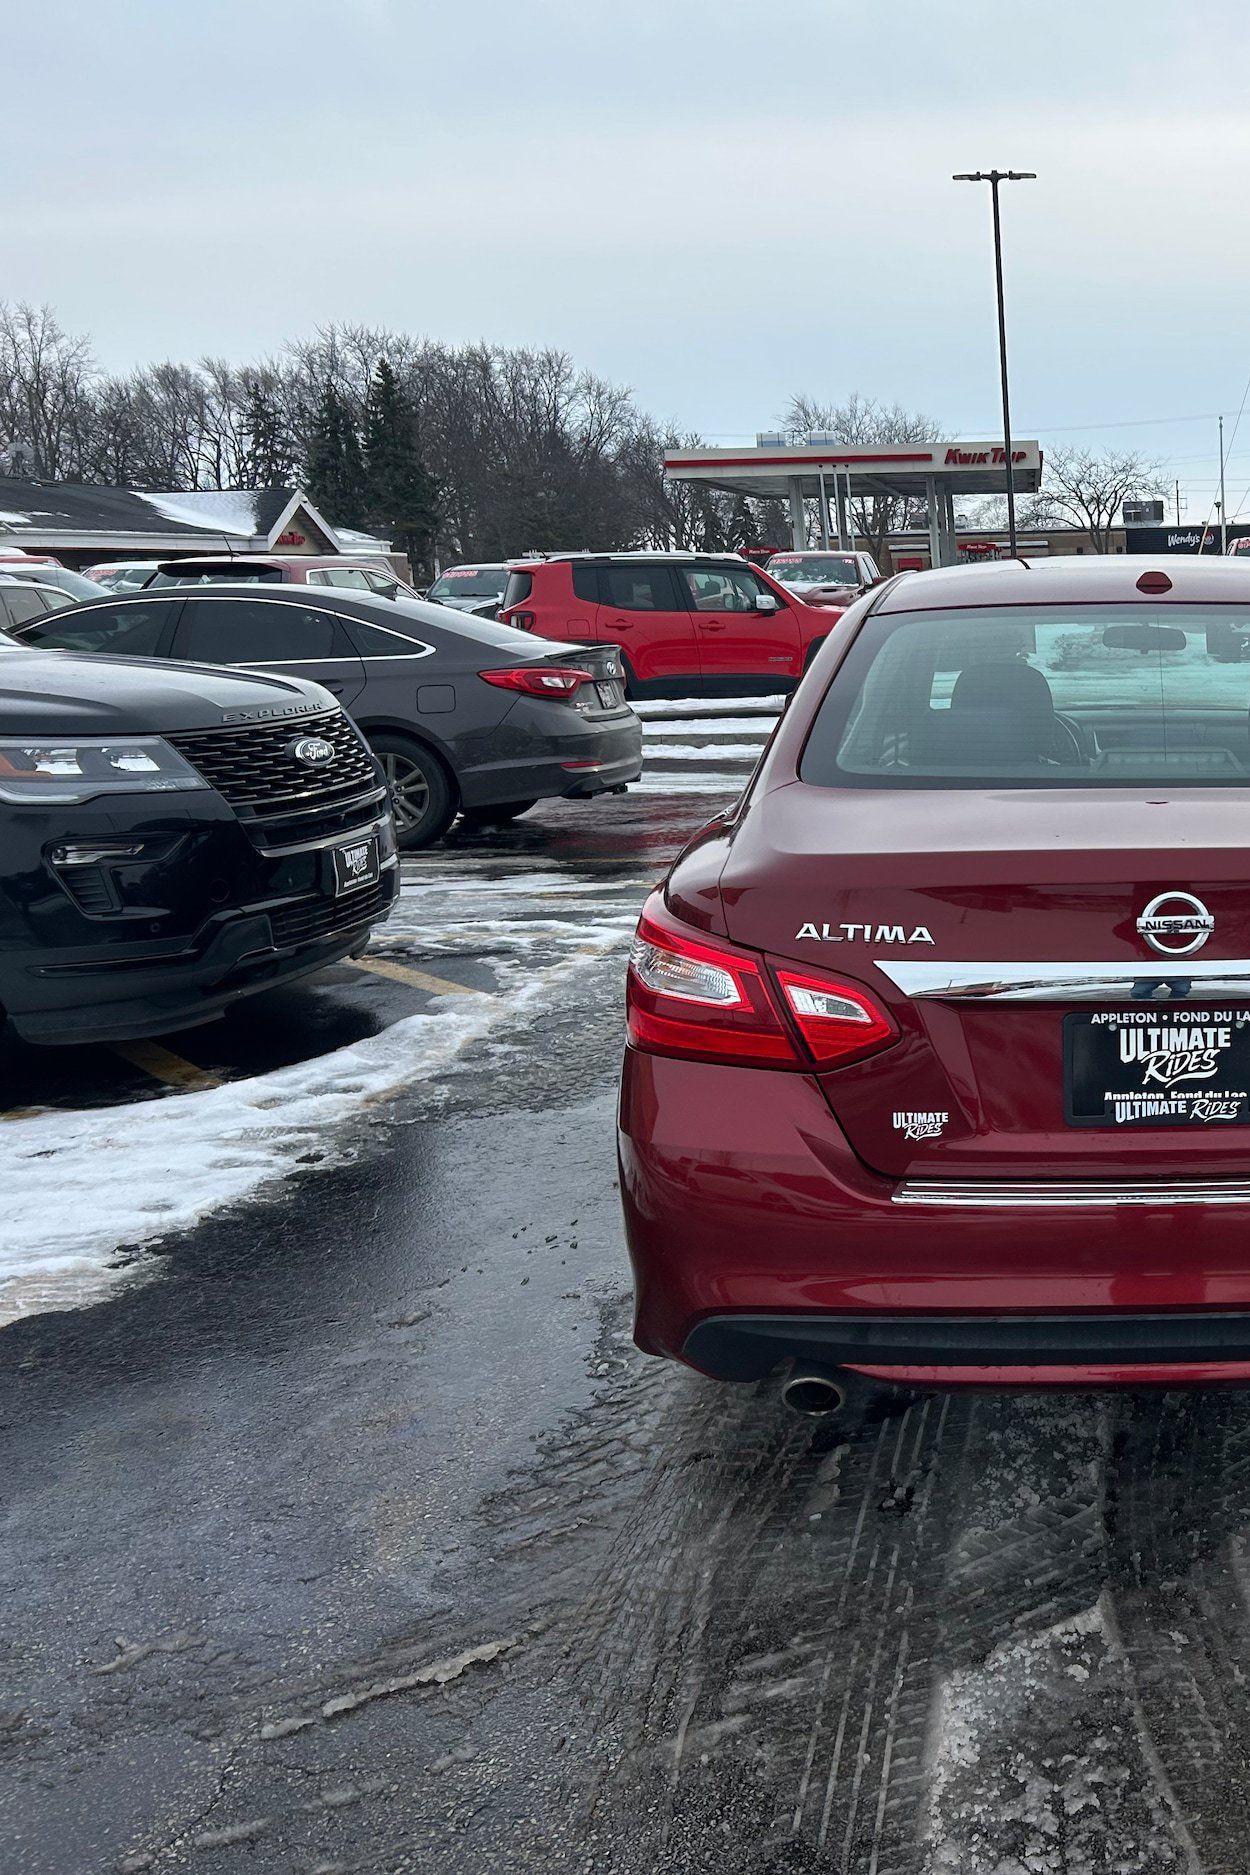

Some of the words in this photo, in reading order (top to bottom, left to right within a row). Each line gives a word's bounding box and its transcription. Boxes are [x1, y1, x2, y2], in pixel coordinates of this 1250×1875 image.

[1168, 532, 1200, 547] Wendy's
[222, 703, 322, 722] EXPLORER
[306, 742, 329, 760] Ford
[795, 923, 936, 945] ALTIMA
[1145, 920, 1209, 931] NISSAN
[1091, 1012, 1157, 1024] APPLETON
[1173, 1012, 1211, 1023] FOND
[1214, 1011, 1232, 1022] DU
[1120, 1027, 1231, 1064] ULTIMATE
[892, 1112, 949, 1129] ULTIMATE
[1115, 1101, 1187, 1124] ULTIMATE
